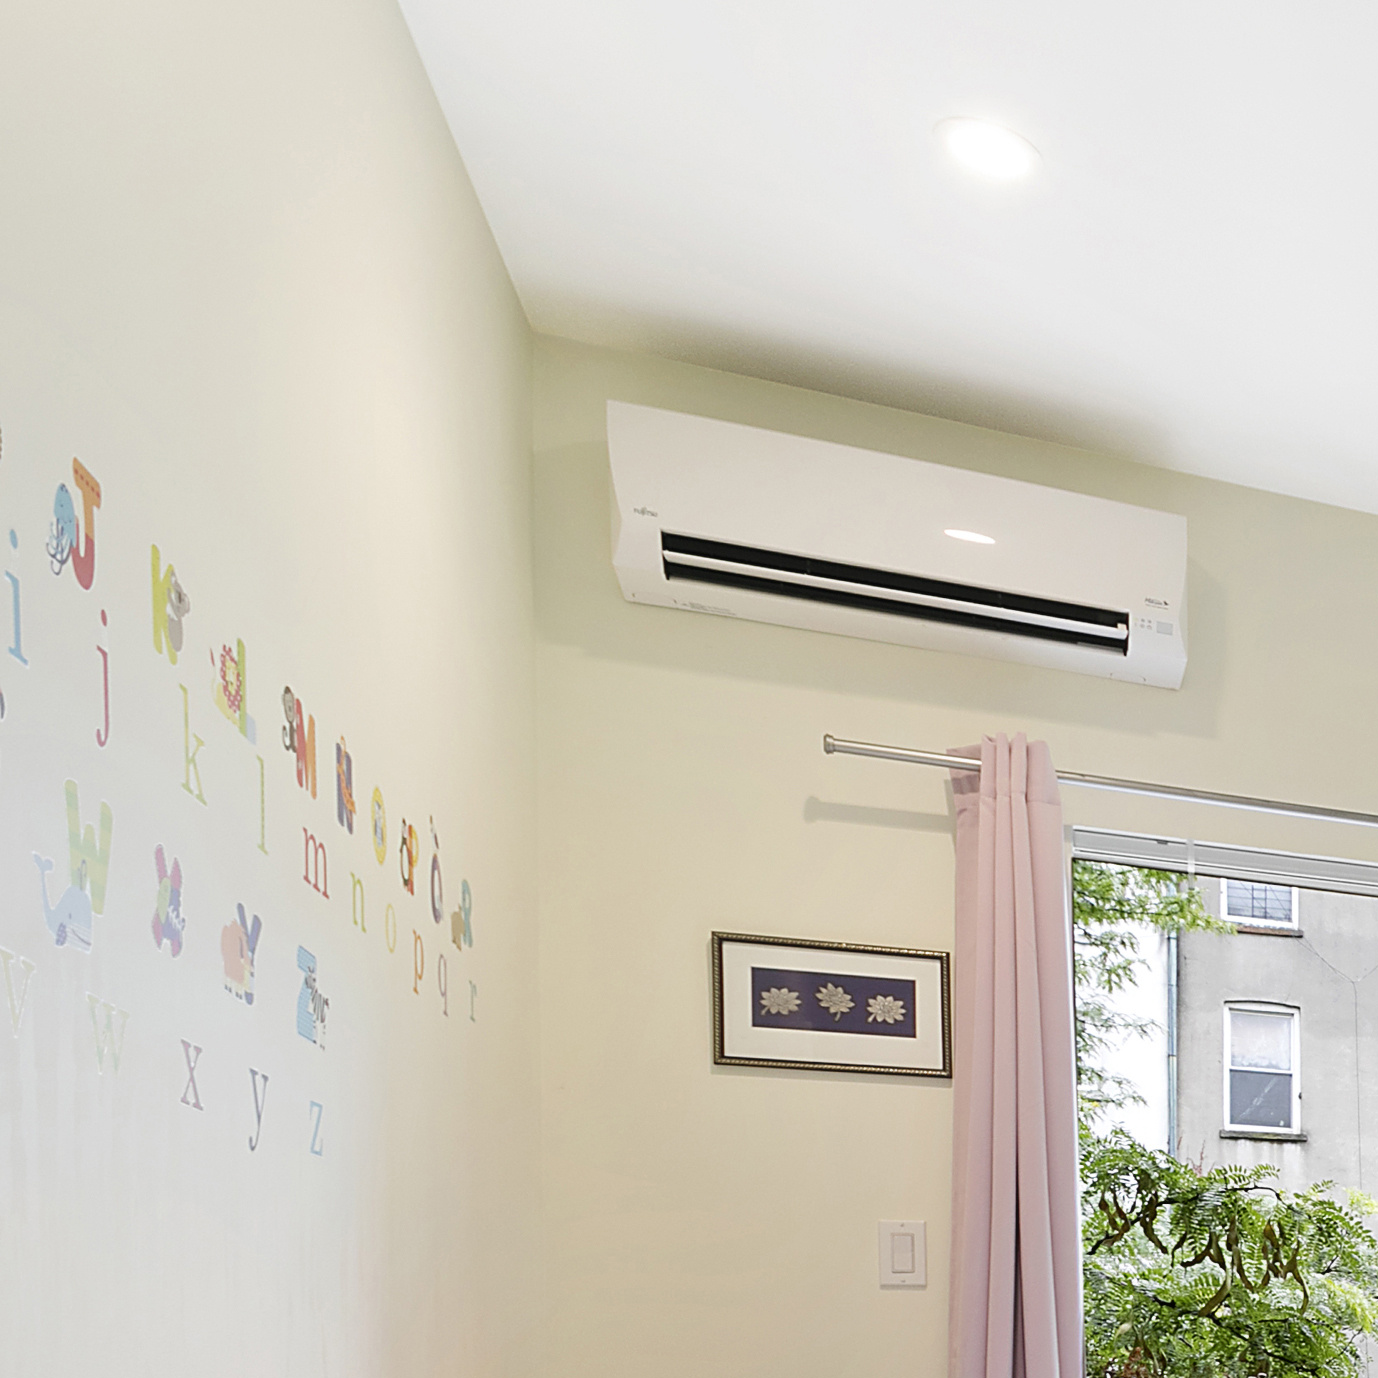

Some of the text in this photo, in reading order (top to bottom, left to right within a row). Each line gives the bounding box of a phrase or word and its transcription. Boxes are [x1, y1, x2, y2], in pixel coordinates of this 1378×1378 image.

[5, 529, 478, 1023] i j k l m n o p q r
[71, 456, 102, 590] J
[151, 543, 179, 667] K
[295, 698, 317, 801] M
[336, 742, 354, 836] N
[371, 787, 387, 865] O
[64, 778, 113, 917] W
[86, 991, 130, 1077] w
[180, 1037, 204, 1111] x
[249, 1066, 269, 1152] y
[309, 1099, 324, 1158] z
